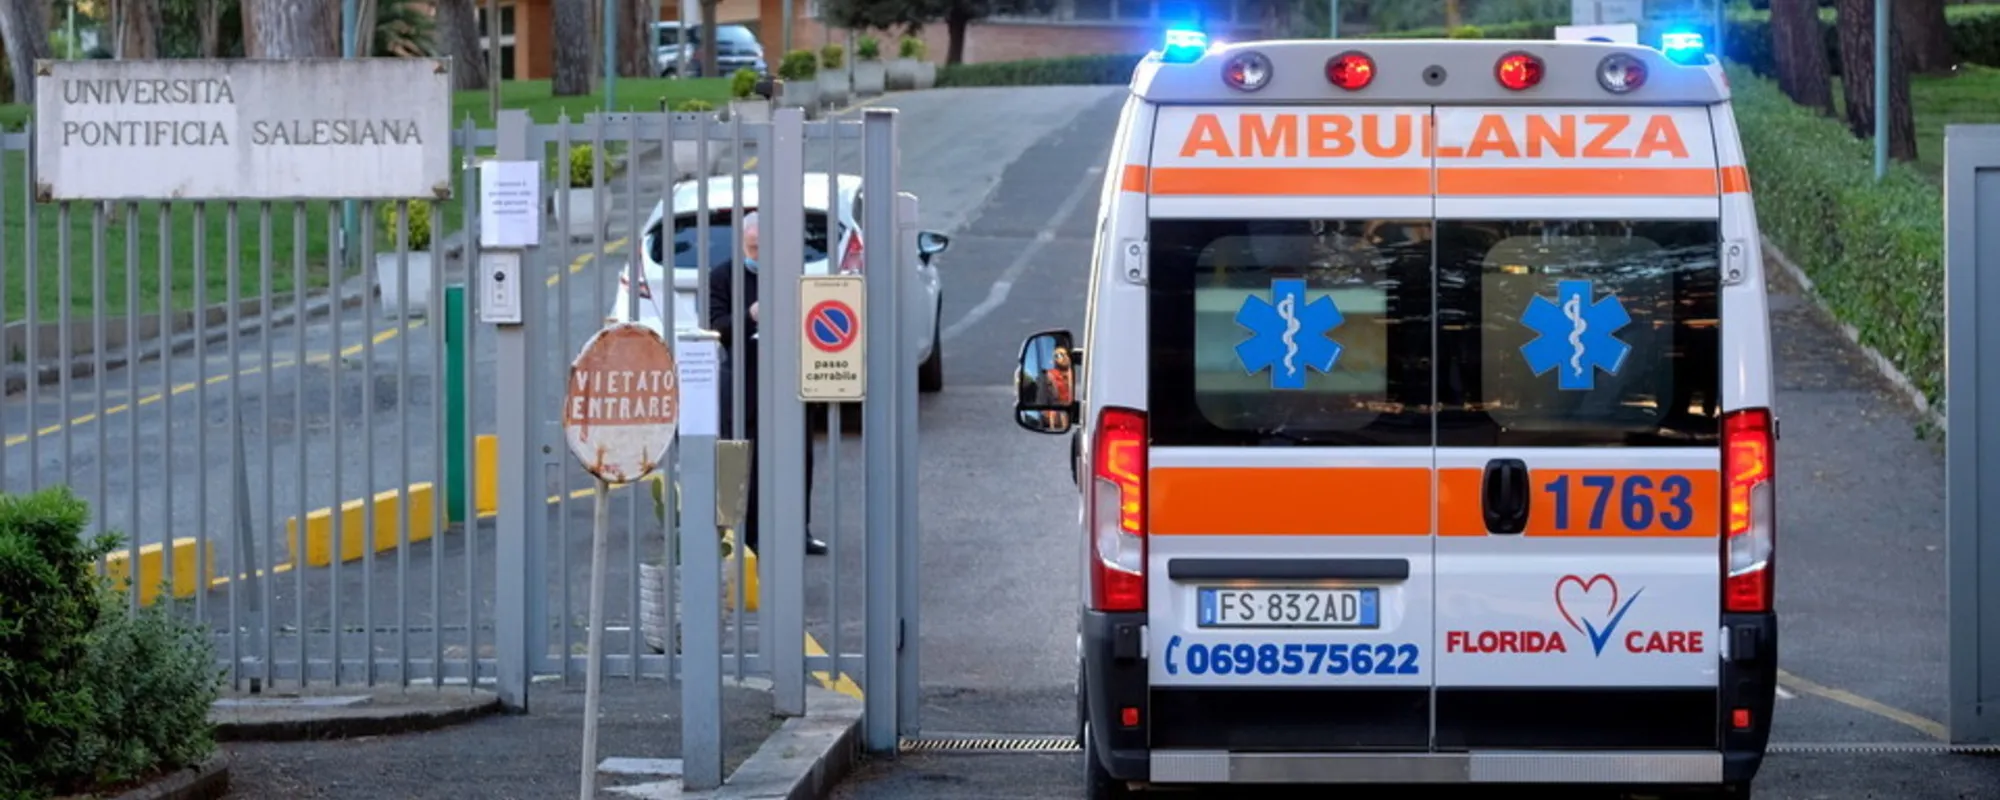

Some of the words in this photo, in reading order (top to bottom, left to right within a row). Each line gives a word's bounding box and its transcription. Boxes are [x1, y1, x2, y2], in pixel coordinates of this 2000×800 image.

[63, 120, 229, 146] PONTIFICIA
[252, 119, 423, 145] SALESIANA
[1179, 113, 1689, 158] AMBULANZA
[805, 371, 857, 381] carrabile
[814, 360, 849, 369] passo
[575, 370, 675, 393] VIETATO
[571, 396, 672, 420] ENTRARE
[1544, 474, 1694, 531] 1763
[1446, 631, 1567, 653] FLORIDA
[1625, 631, 1704, 653] CARE
[1186, 643, 1419, 675] 0698575622
